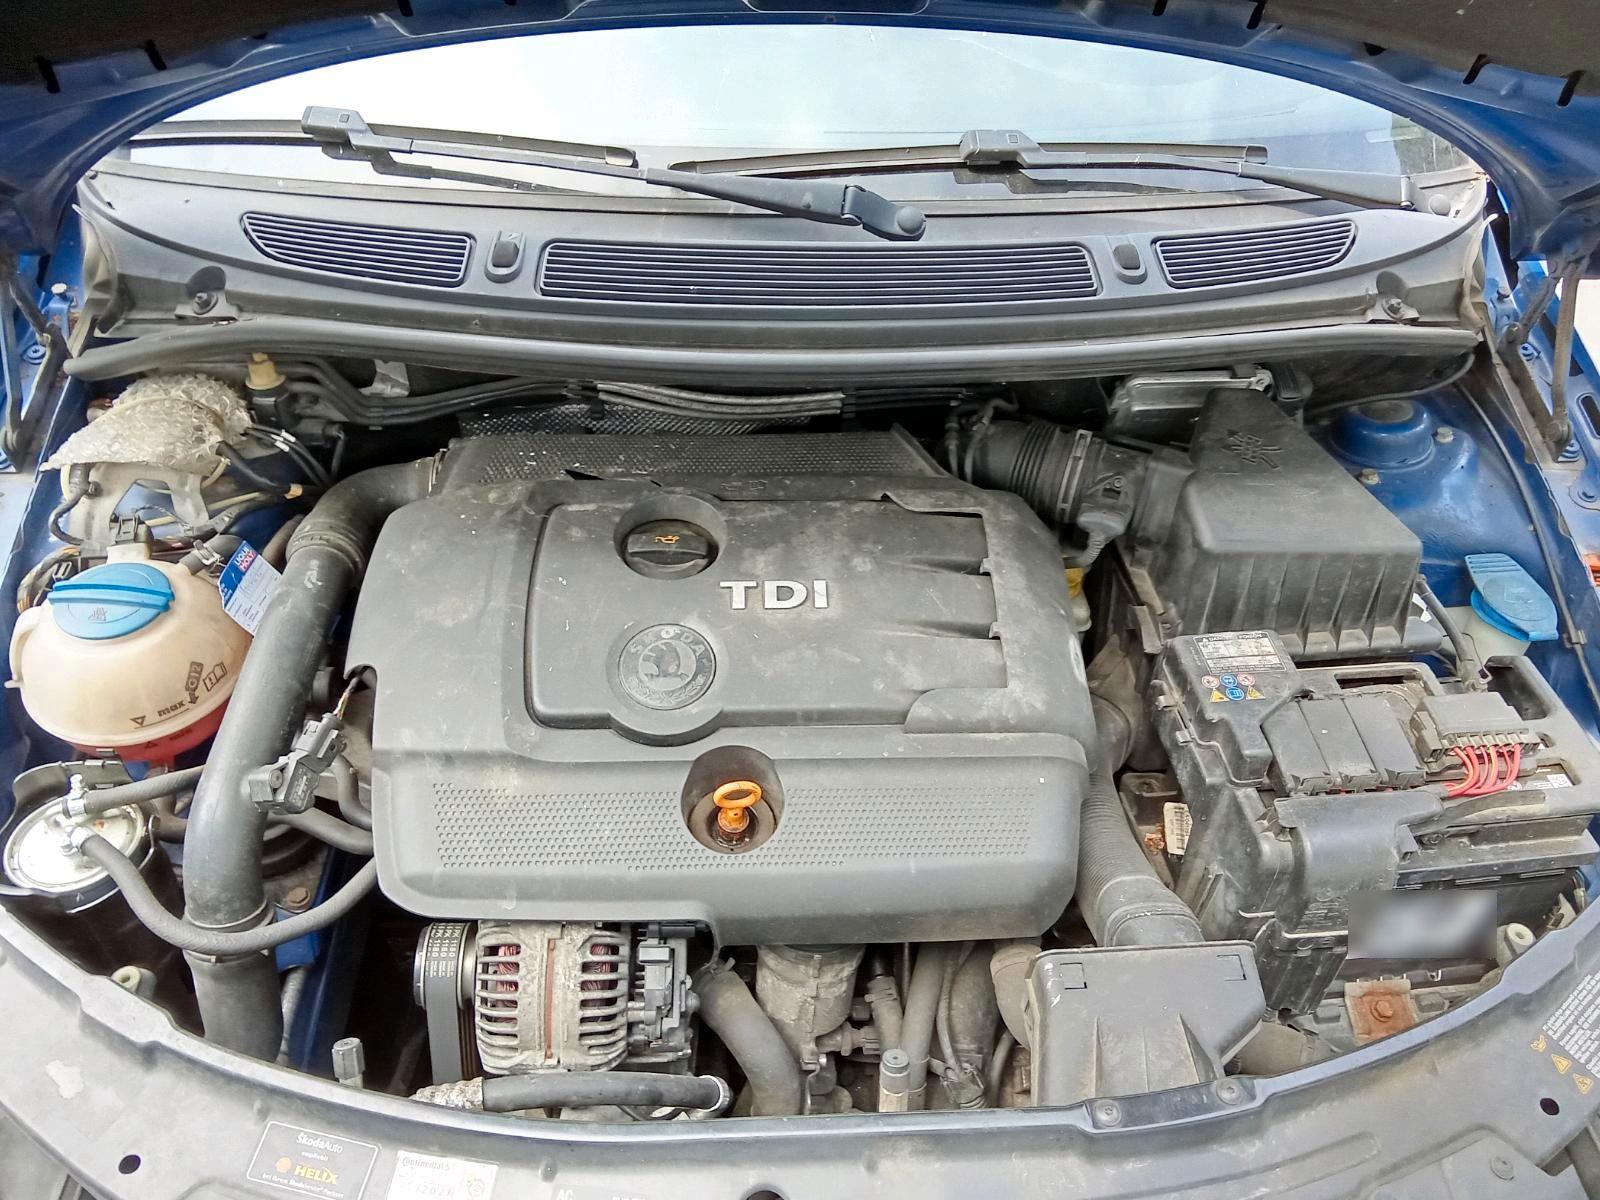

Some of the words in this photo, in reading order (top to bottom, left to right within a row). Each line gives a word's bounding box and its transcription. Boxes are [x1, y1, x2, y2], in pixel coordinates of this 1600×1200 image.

[234, 546, 250, 565] LIQUI
[240, 550, 257, 572] MOLY
[719, 580, 829, 610] TDI
[157, 700, 186, 717] max
[294, 1164, 338, 1185] HELIX
